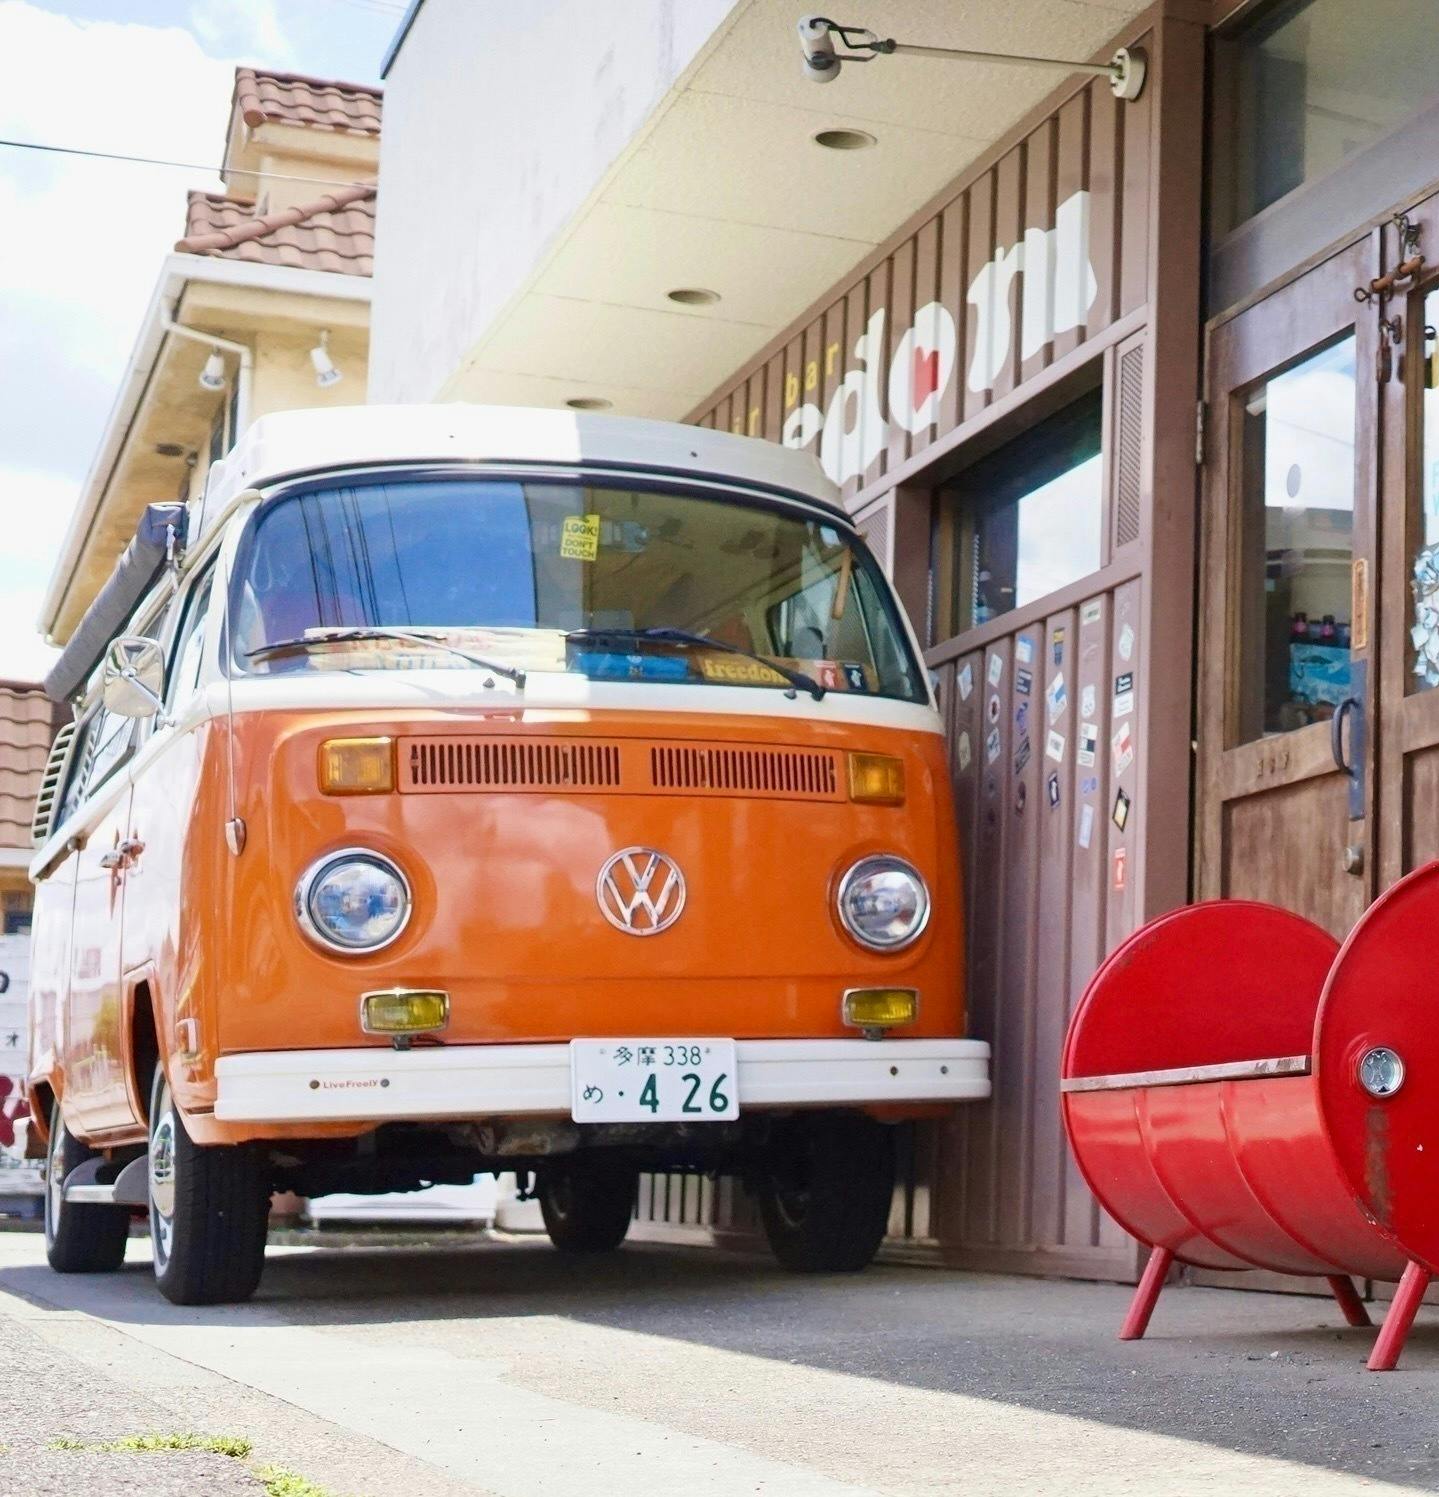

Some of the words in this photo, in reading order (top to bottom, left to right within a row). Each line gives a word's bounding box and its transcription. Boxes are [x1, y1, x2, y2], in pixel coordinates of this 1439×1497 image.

[782, 190, 1098, 487] edom
[784, 342, 839, 408] bar
[604, 852, 681, 930] VW
[613, 1046, 657, 1067] 多摩
[663, 1046, 701, 1066] 338
[583, 1084, 603, 1104] め
